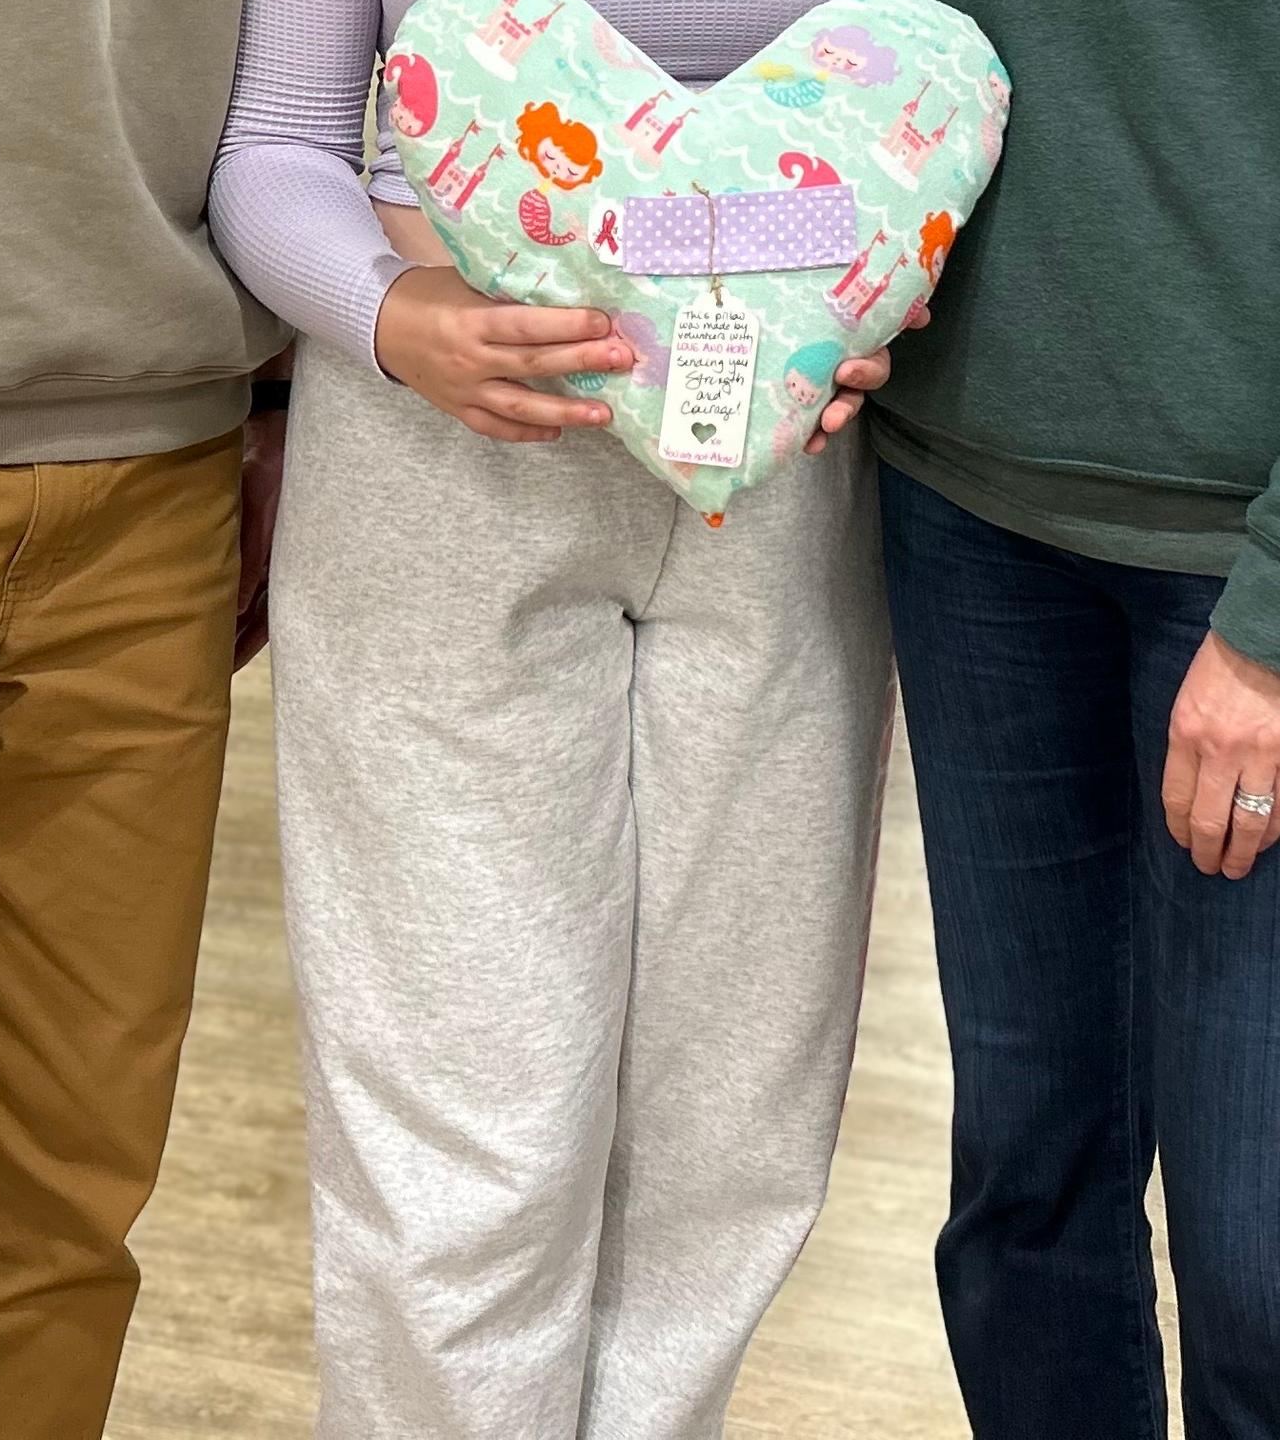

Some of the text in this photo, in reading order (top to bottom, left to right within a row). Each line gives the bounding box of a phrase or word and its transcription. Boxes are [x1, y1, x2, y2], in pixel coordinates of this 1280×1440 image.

[682, 311, 746, 322] This pillow
[679, 322, 748, 333] was made by
[677, 342, 699, 352] LOVE
[702, 343, 723, 353] AND
[677, 356, 749, 375] Sending you
[685, 370, 744, 395] Strength
[696, 390, 721, 401] and
[681, 400, 741, 421] Courage!
